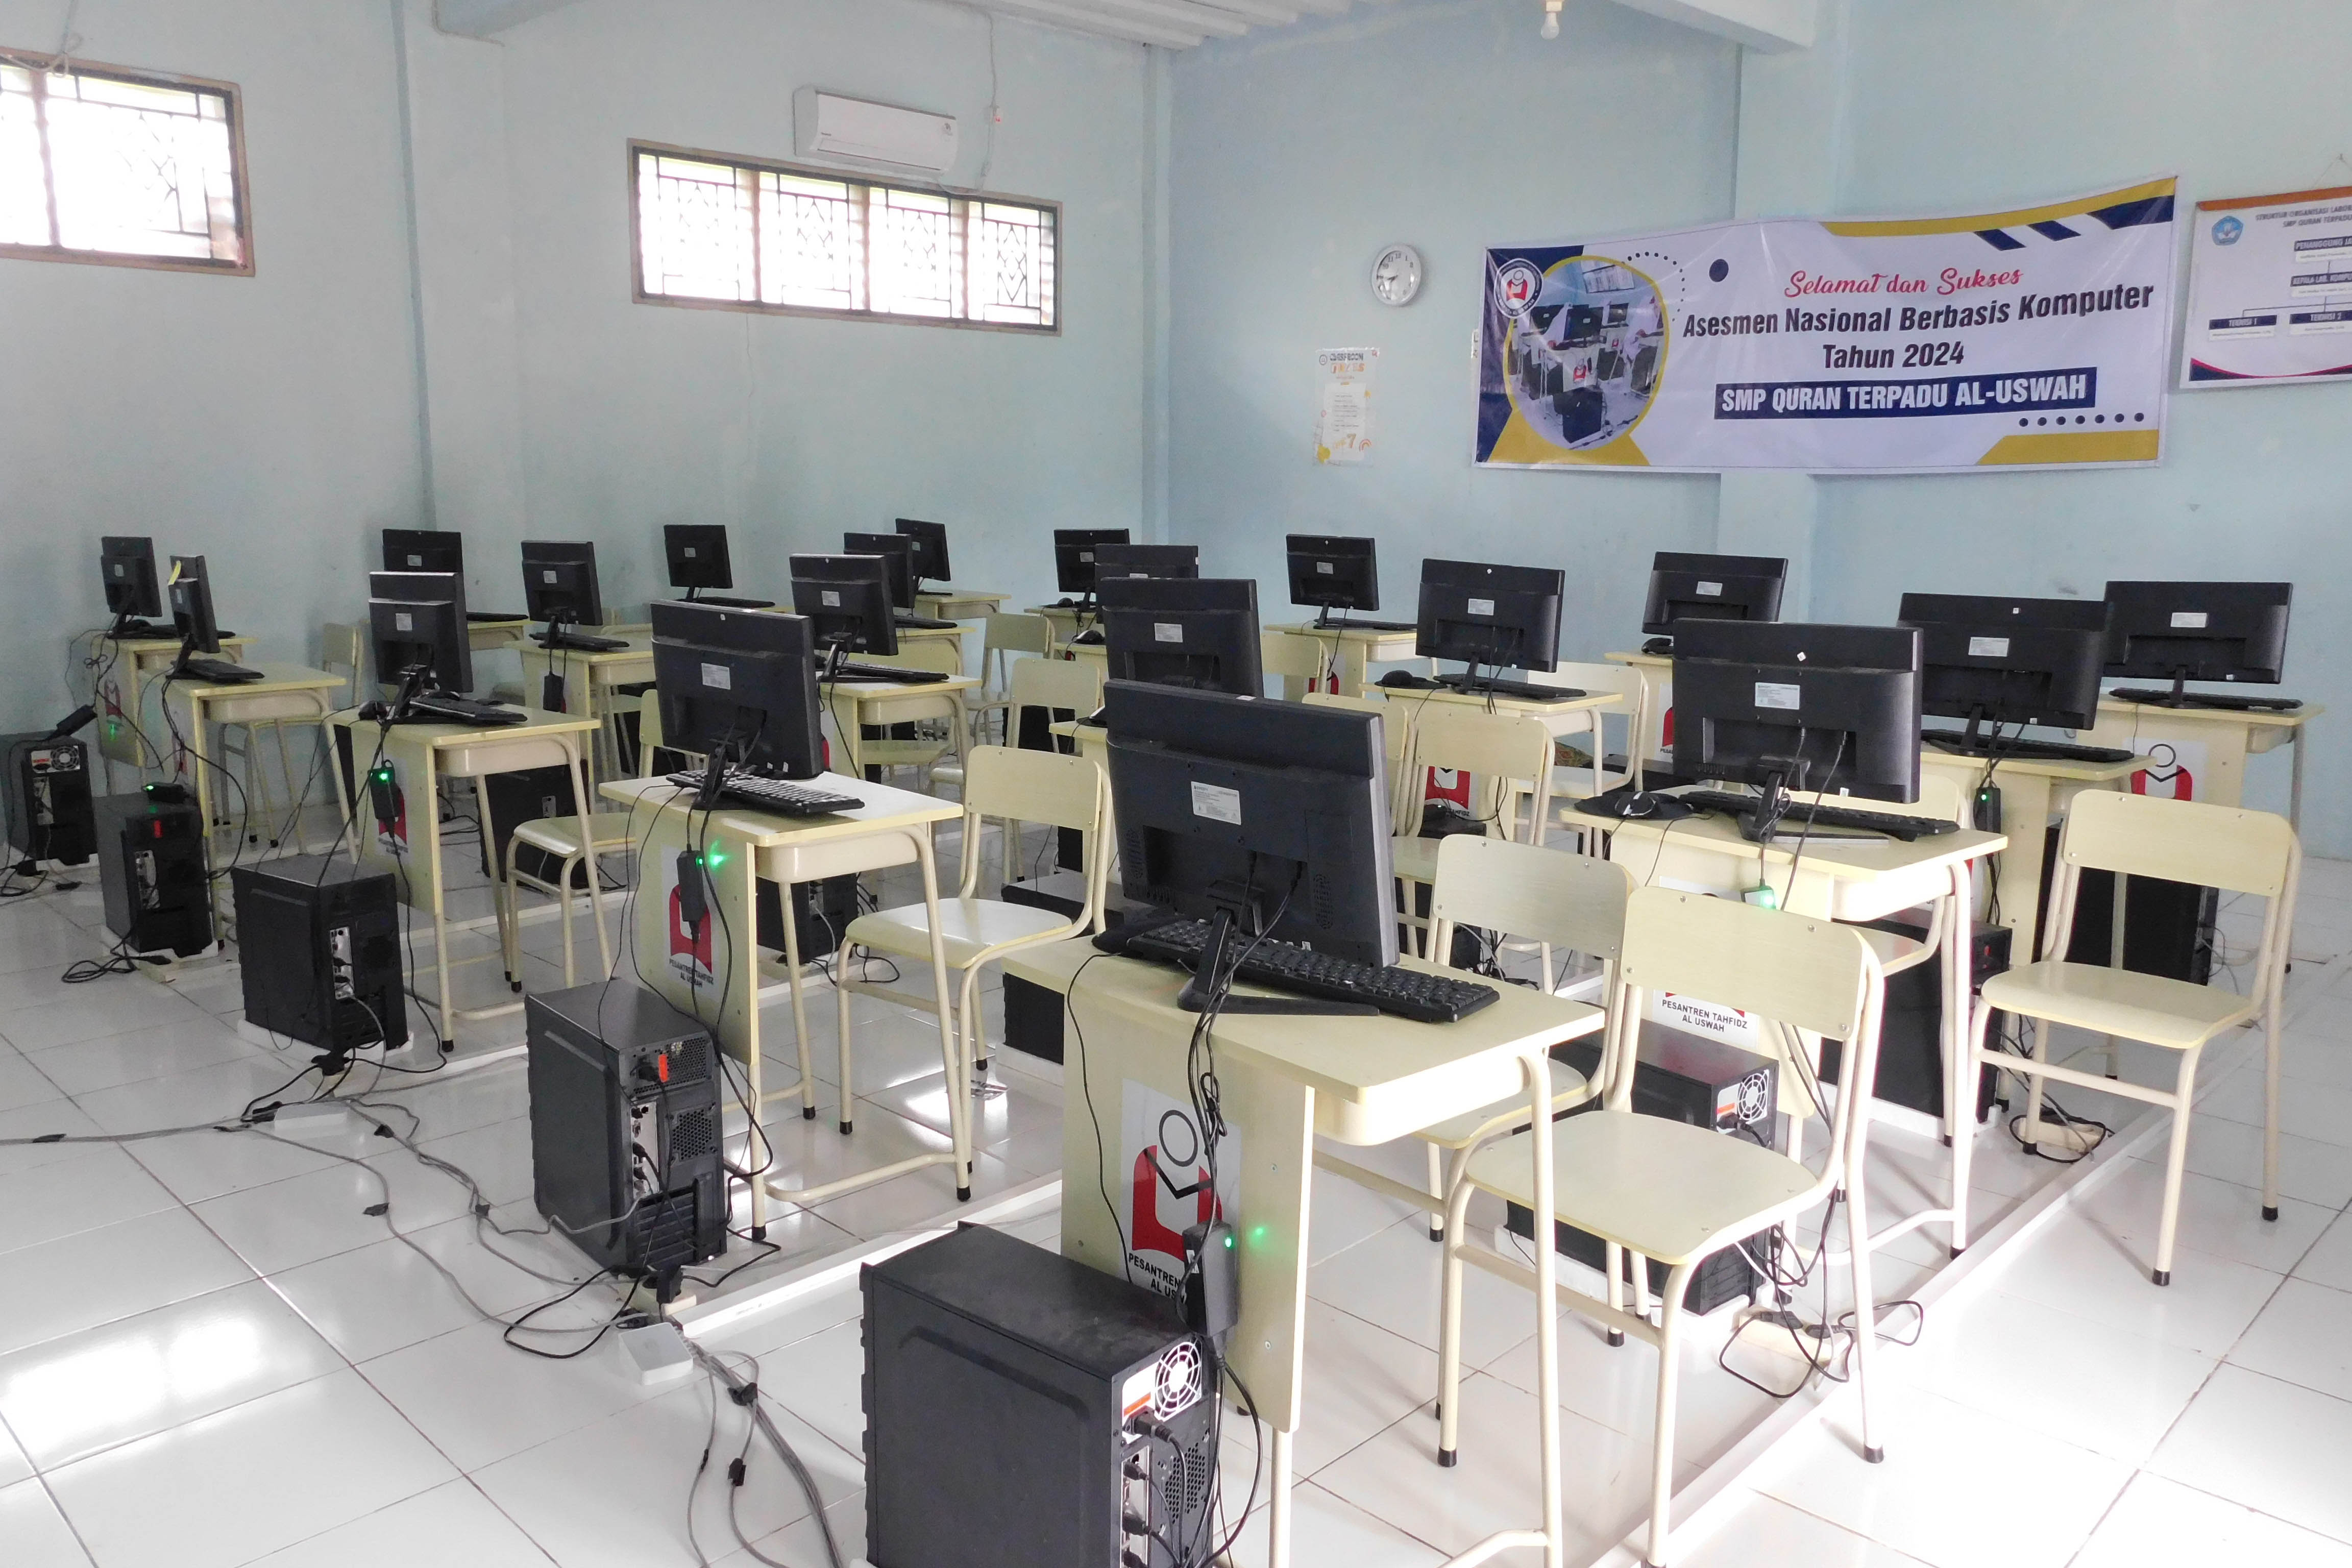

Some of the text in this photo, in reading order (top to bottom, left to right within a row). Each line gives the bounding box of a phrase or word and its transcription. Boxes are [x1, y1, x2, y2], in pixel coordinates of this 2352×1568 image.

[1784, 267, 2024, 298] Selamat dan Sukses
[1683, 284, 2154, 337] Asesmen Nasional Berbasis Komputer
[1823, 341, 1965, 369] Tahun 2024
[1722, 374, 2087, 413] SMP QURAN TERPADU AL-USWAH
[1662, 999, 1747, 1029] PESANTREN TAHFIDZ
[1682, 1015, 1724, 1033] AL USWAH
[1129, 1253, 1181, 1288] PESANTREN
[1151, 1278, 1162, 1293] AL
